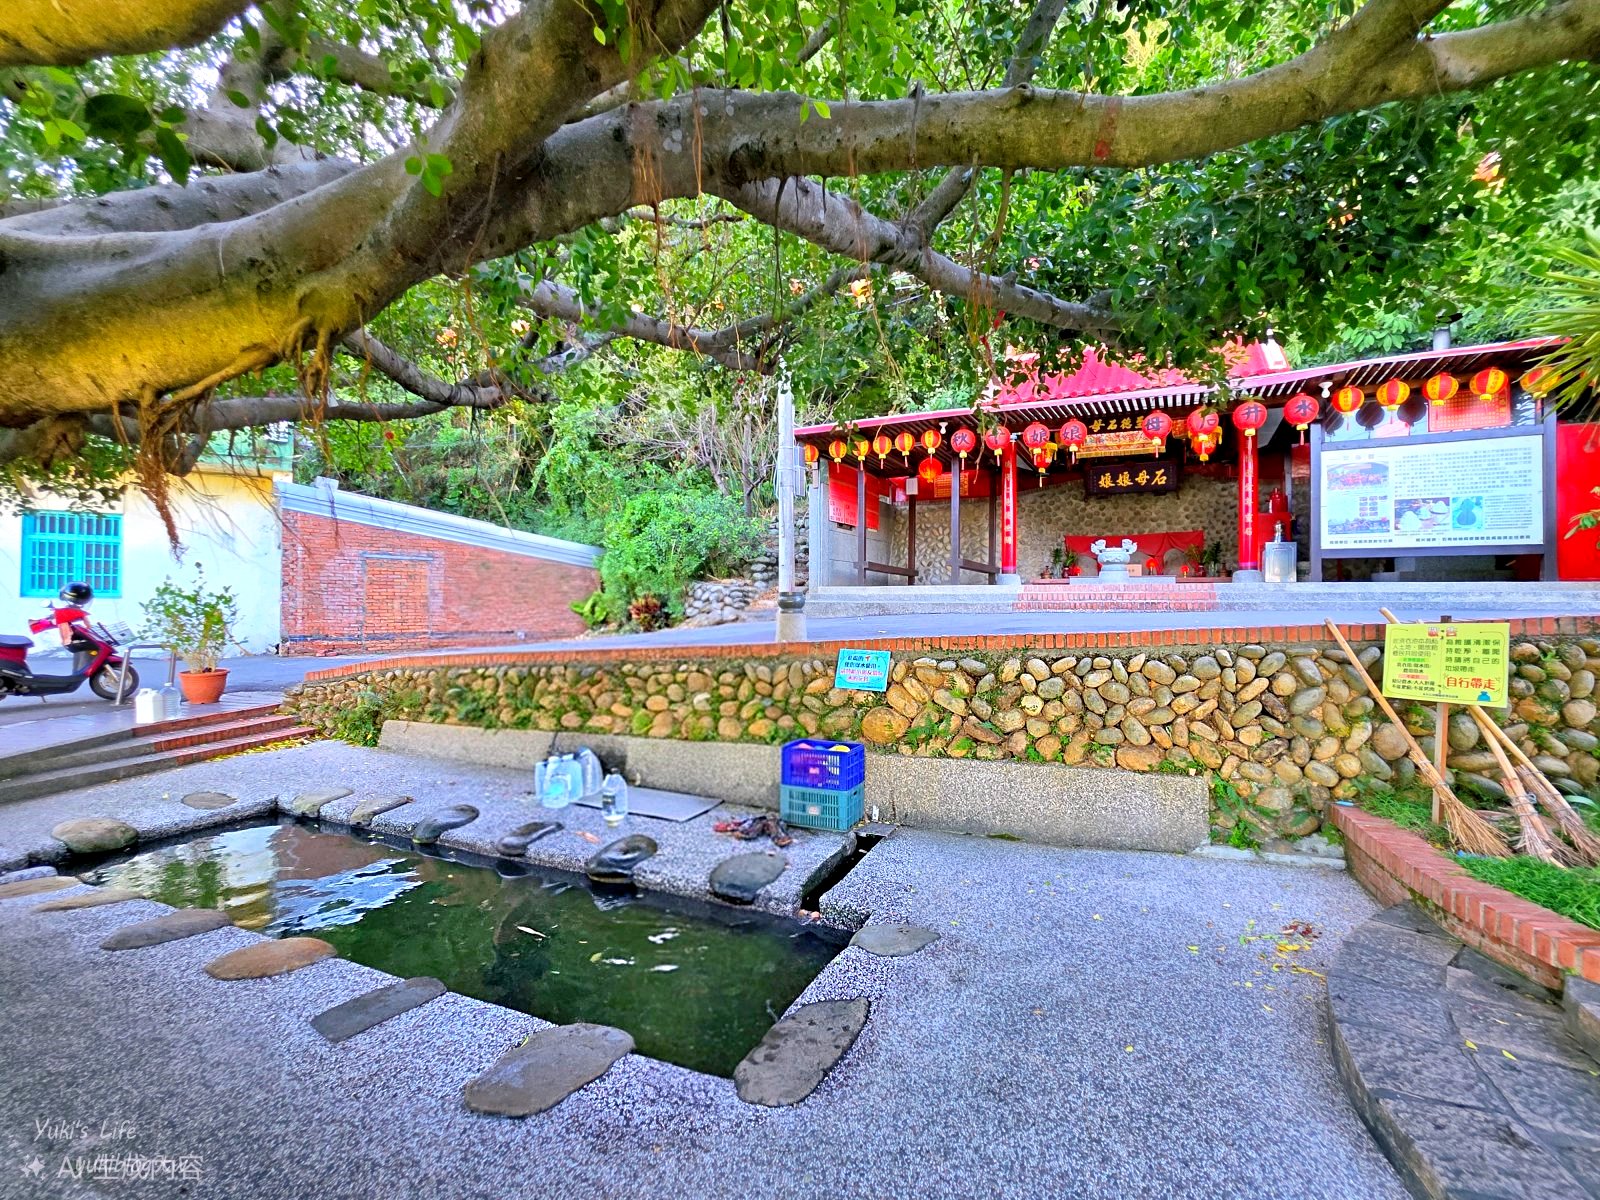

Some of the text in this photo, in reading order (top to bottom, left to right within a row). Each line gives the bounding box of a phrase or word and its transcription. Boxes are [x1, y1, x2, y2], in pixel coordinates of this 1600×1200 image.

[1241, 404, 1262, 422] 井
[1295, 399, 1314, 416] 水
[1145, 416, 1165, 431] 母
[952, 432, 970, 447] 秋
[1031, 429, 1049, 442] 娘
[1062, 425, 1082, 440] 娘
[1098, 468, 1167, 488] 石母娘娘
[1446, 677, 1496, 690] 自行帶走
